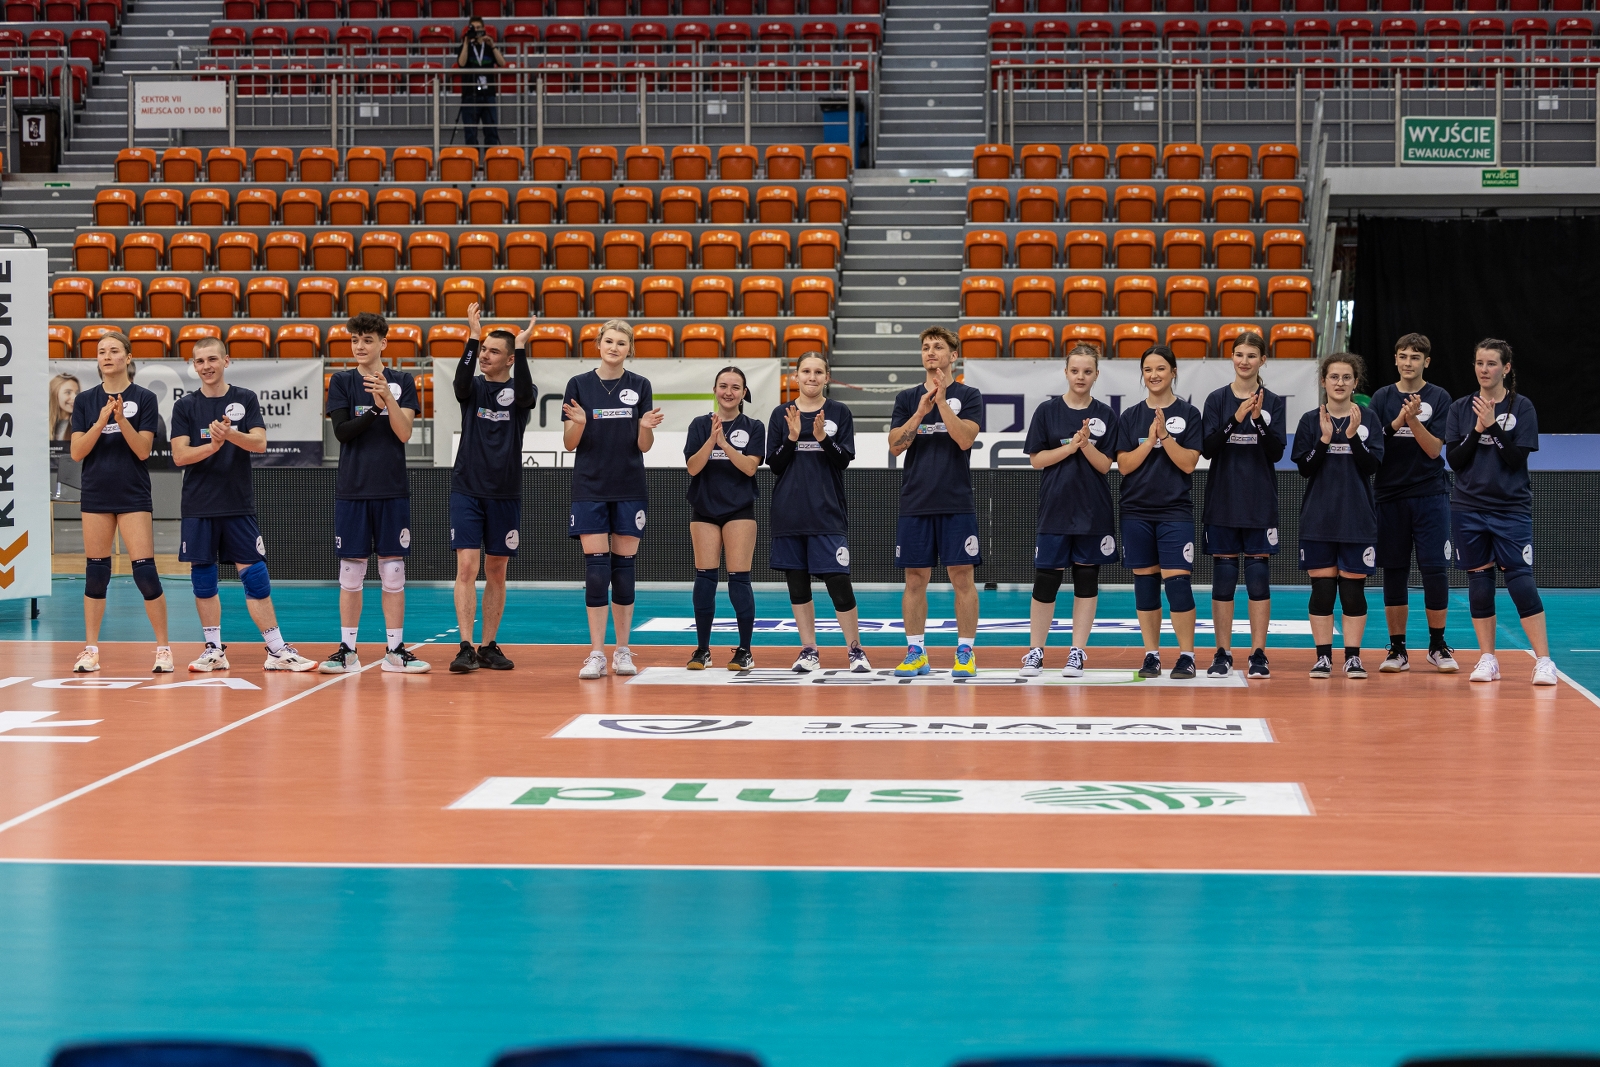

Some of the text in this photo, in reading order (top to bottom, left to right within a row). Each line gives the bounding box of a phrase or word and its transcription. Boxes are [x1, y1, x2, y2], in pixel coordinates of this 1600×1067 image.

[1408, 122, 1491, 143] WYJŚCIE
[1408, 147, 1491, 159] EWAKUACYJNE
[260, 386, 308, 400] nauki
[259, 403, 291, 416] atu!
[804, 722, 1242, 731] JONATAN
[510, 783, 964, 805] plus
